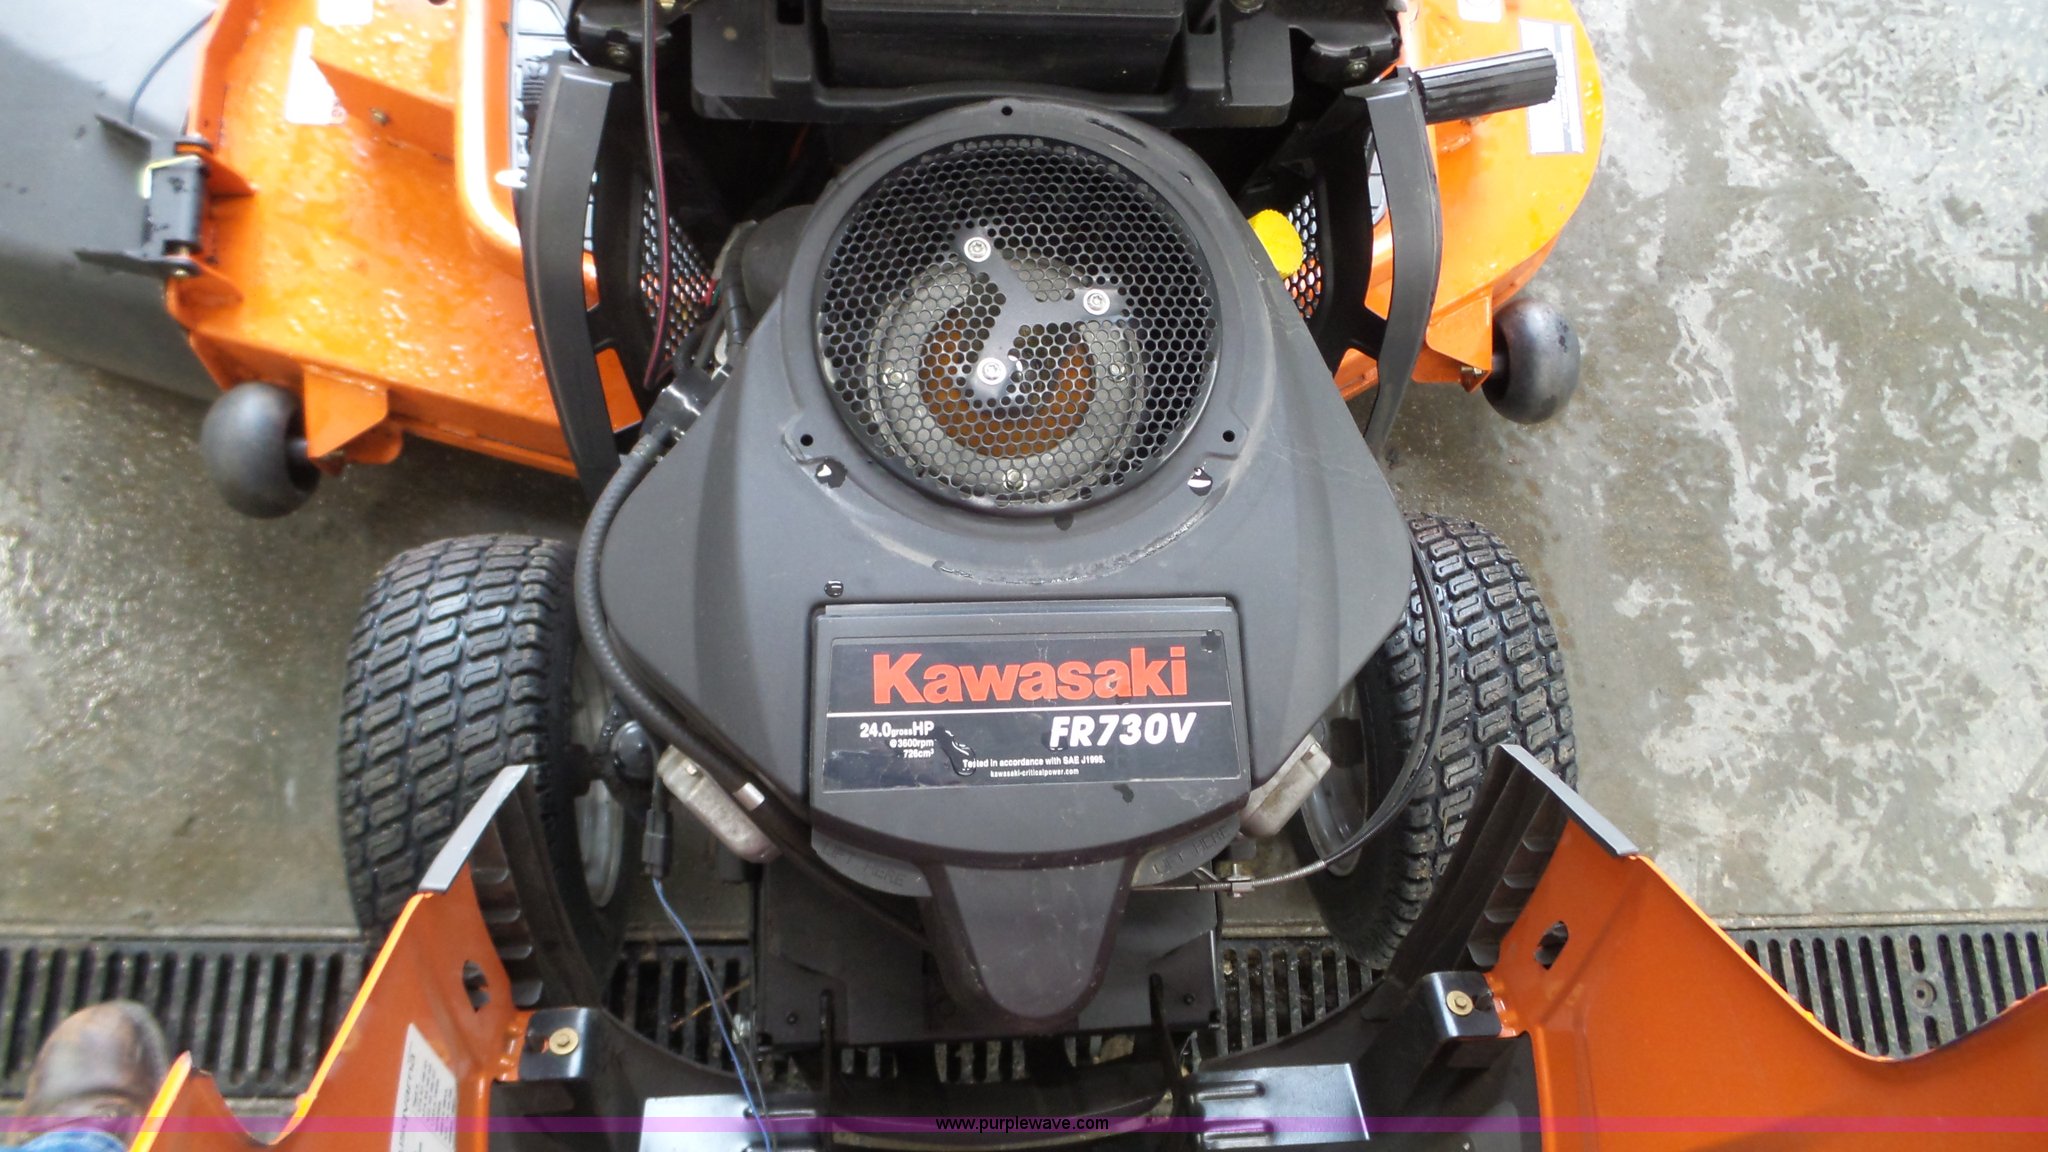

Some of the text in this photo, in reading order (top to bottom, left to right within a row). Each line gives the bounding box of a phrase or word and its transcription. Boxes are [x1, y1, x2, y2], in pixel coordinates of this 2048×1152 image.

[872, 646, 1188, 705] Kawasaki
[1050, 712, 1197, 748] FR730V
[962, 758, 989, 769] Tested
[990, 758, 999, 767] in
[999, 756, 1044, 767] accordance
[1045, 755, 1062, 766] with
[1063, 754, 1080, 765] SAE
